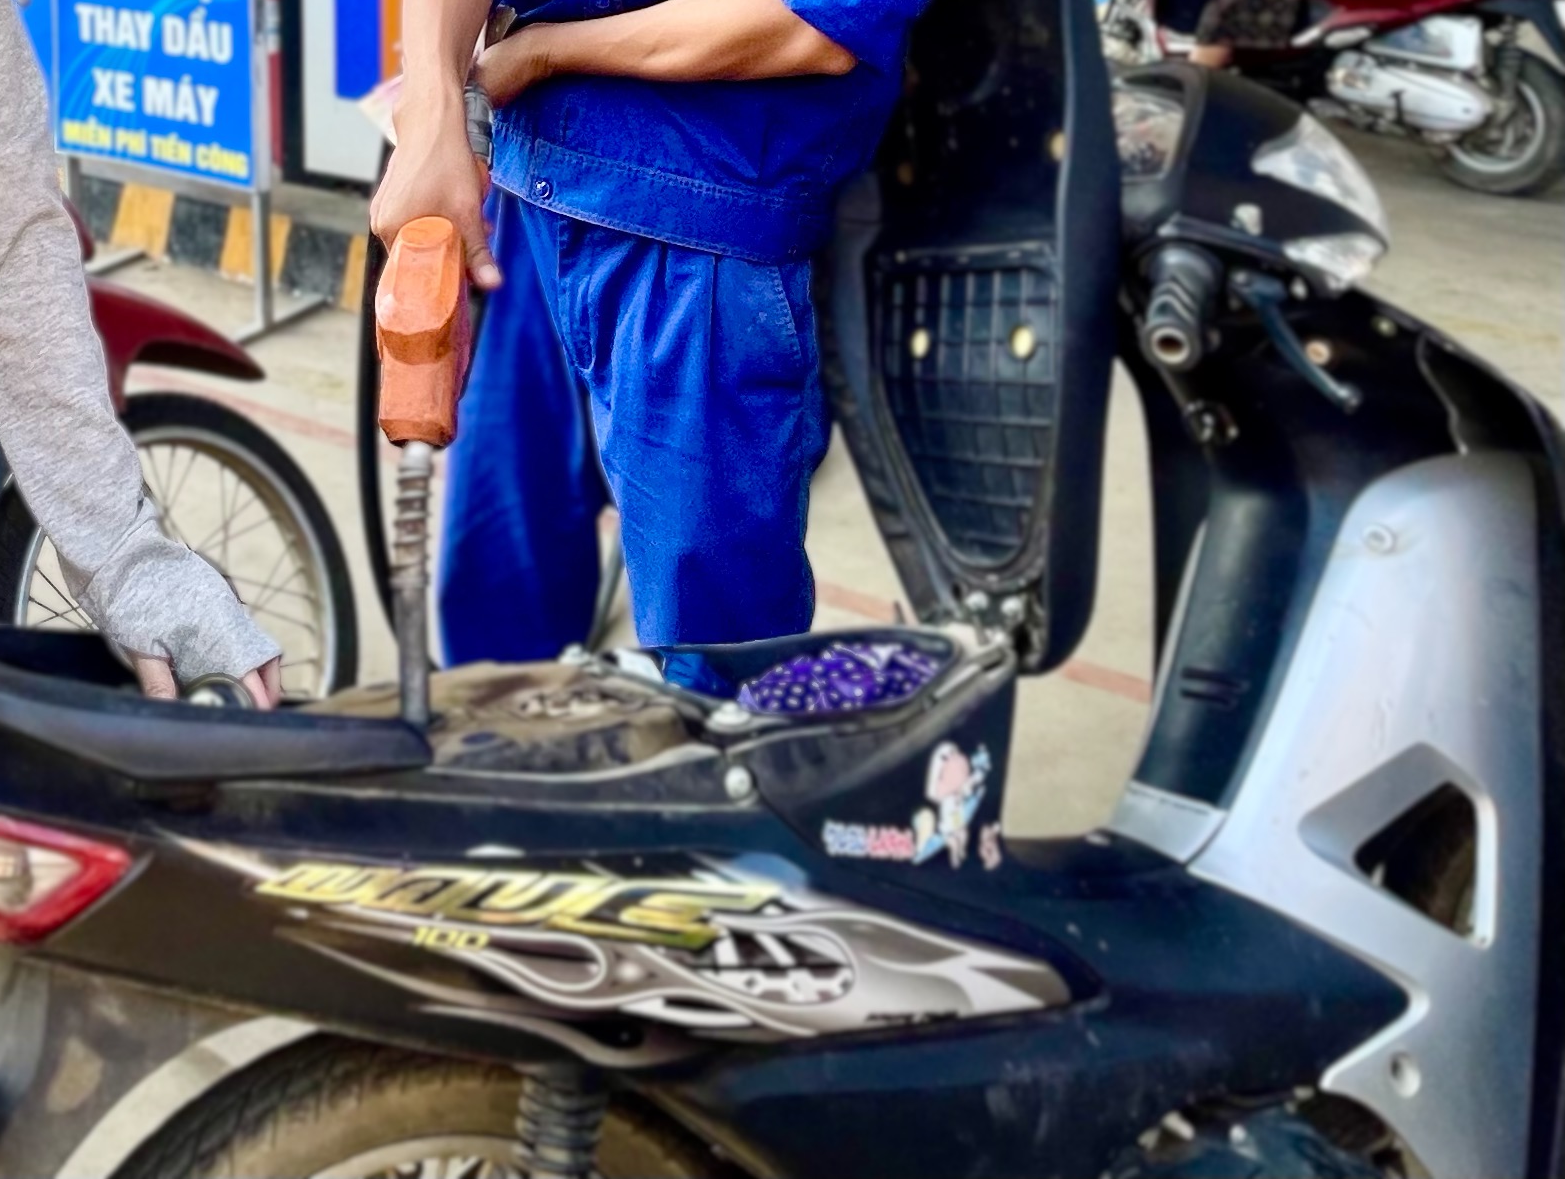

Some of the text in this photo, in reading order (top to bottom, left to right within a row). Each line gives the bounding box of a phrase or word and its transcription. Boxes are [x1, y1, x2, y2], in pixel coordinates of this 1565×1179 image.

[75, 3, 233, 65] THAY DẦU
[92, 67, 219, 127] XE MÁY
[115, 124, 148, 157] PHÍ
[196, 140, 249, 179] CÔNG
[412, 926, 491, 951] 100
